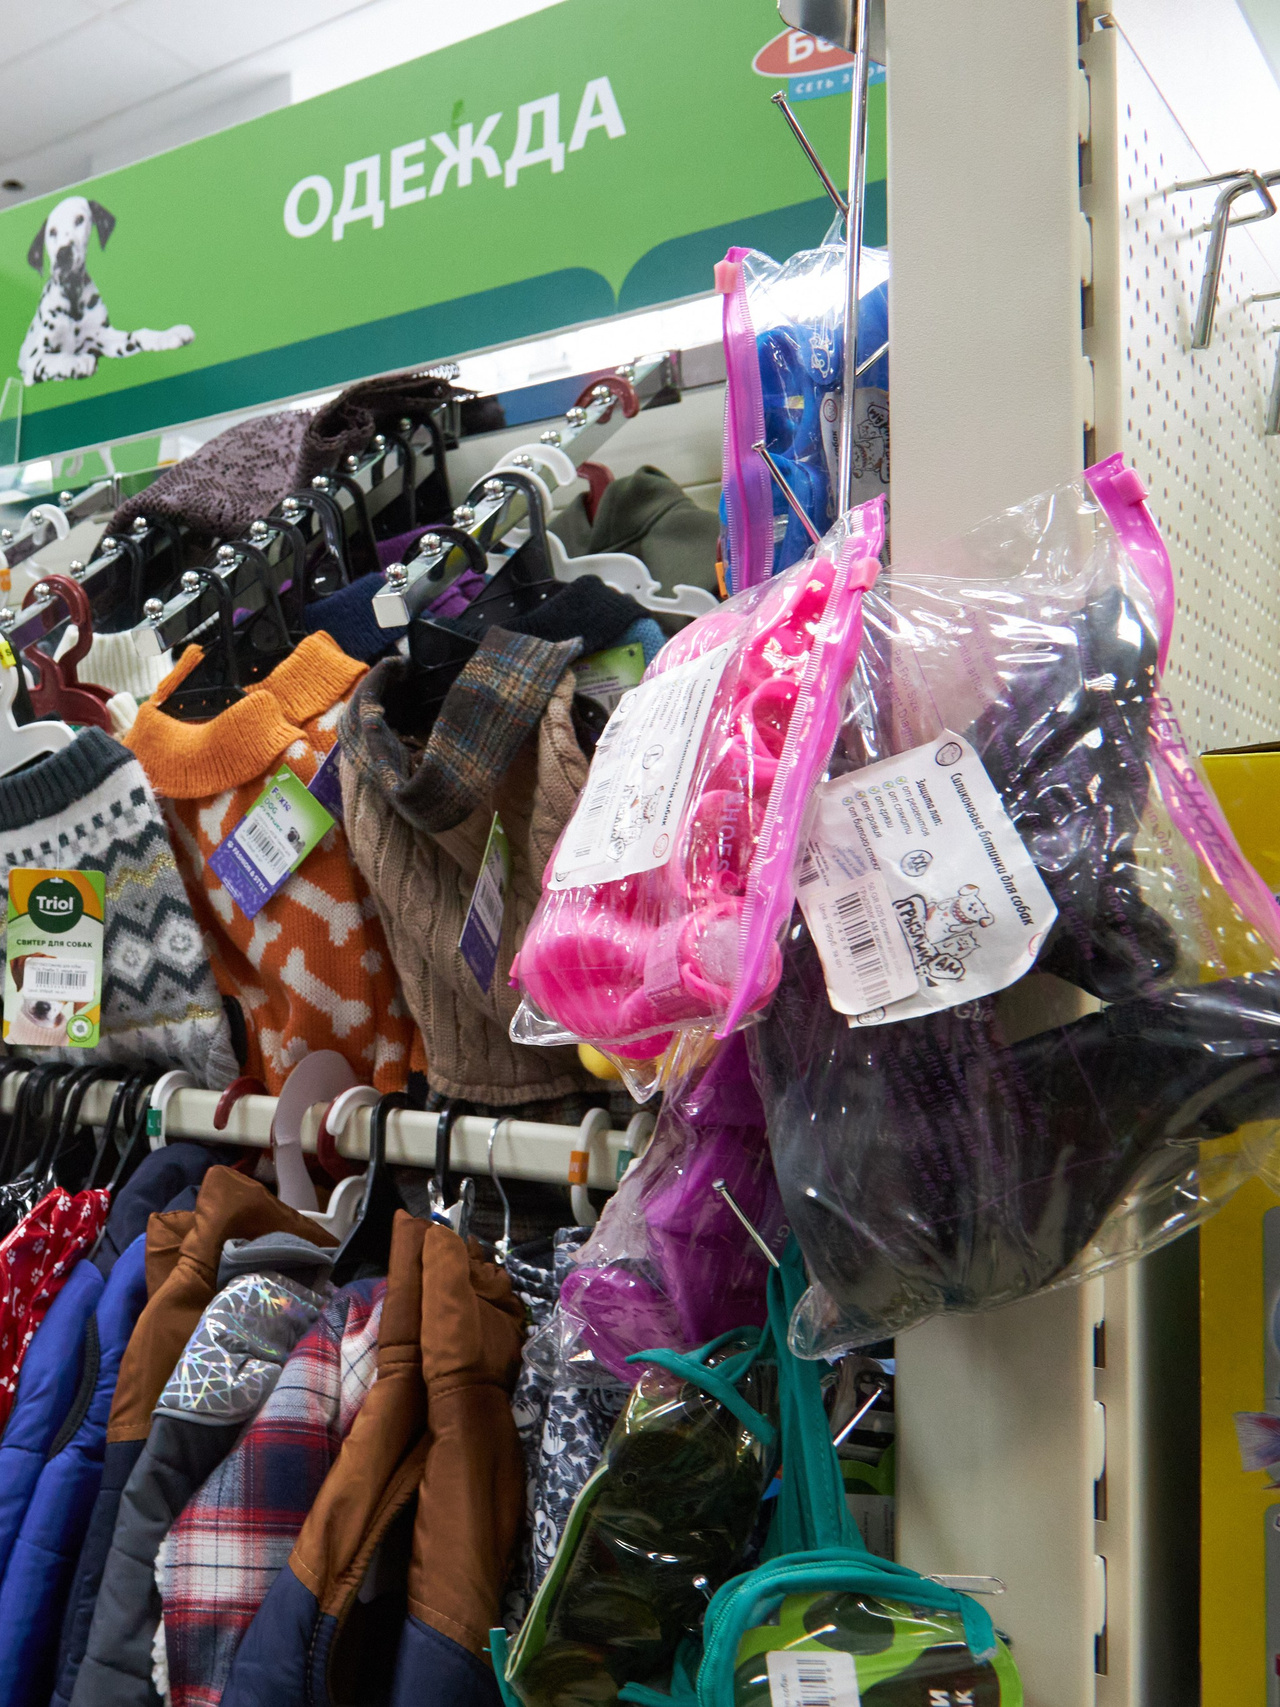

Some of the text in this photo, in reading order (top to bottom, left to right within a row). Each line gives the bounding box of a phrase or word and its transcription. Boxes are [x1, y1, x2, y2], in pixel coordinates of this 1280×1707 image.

[795, 79, 834, 94] СЕТЬ
[284, 75, 626, 241] ОДЕЖДА
[906, 691, 921, 712] Size
[271, 786, 292, 812] Foxie
[916, 778, 943, 827] Защита лап:
[1147, 696, 1235, 881] PET SHOES
[264, 797, 278, 815] DOG
[659, 799, 673, 827] собак
[848, 805, 858, 818] от
[860, 800, 881, 839] от гравия
[874, 794, 893, 829] от грязи
[888, 790, 912, 835] от слякоти
[901, 785, 929, 837] от реагентов
[852, 817, 871, 847] битого
[911, 853, 927, 872] XXL
[950, 771, 1036, 927] Силиконовые ботинки для собак
[232, 846, 252, 871] FASHION
[253, 874, 268, 894] STYLE
[36, 896, 74, 911] Triol
[16, 939, 46, 947] СВИТЕР
[934, 954, 960, 978] АМ
